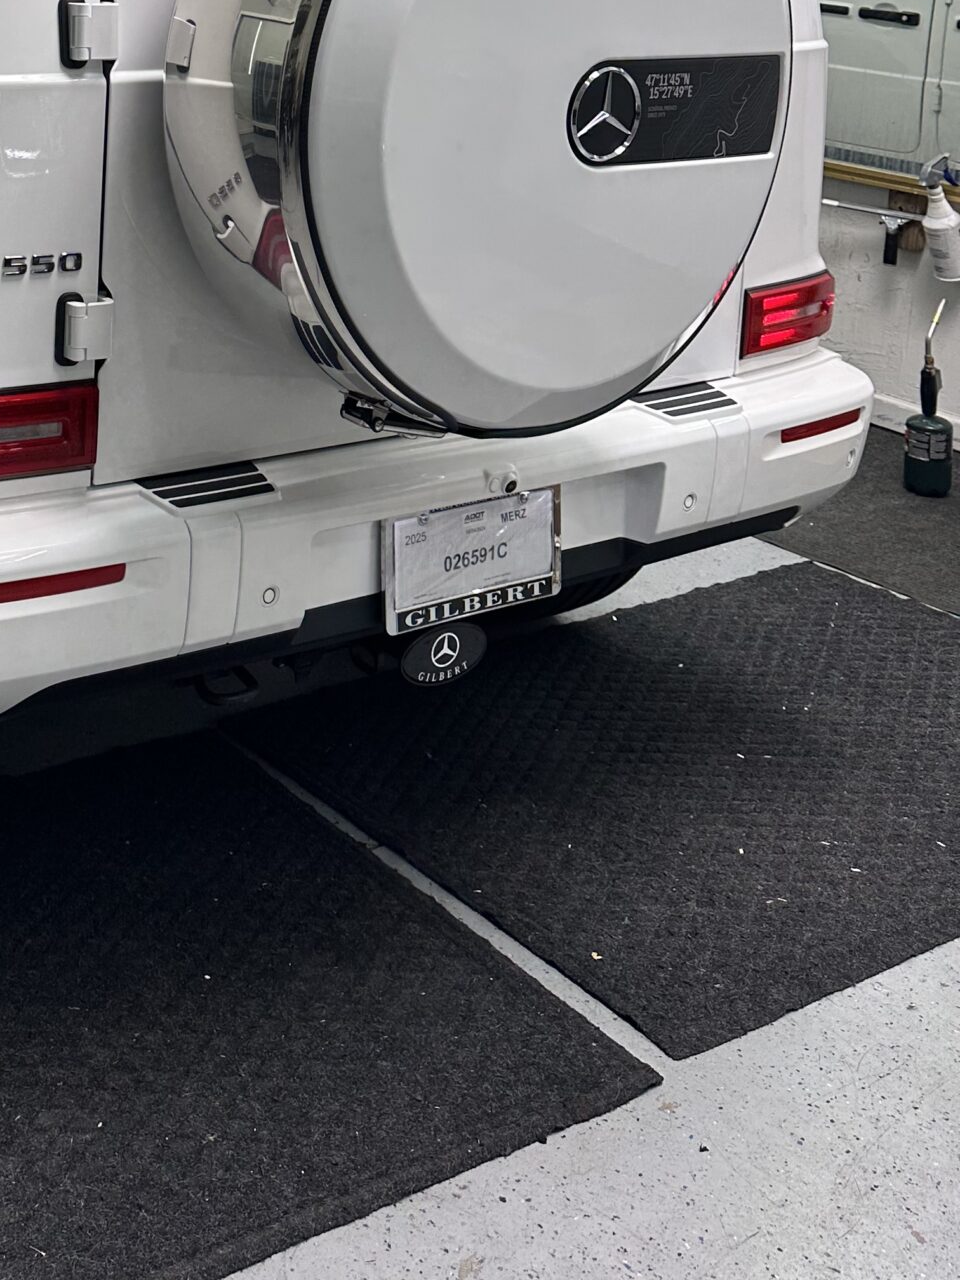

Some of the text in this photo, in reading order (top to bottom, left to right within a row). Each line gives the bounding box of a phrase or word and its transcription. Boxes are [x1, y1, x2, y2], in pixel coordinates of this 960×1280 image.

[2, 252, 83, 276] 550
[500, 508, 528, 524] MERZ
[405, 531, 427, 546] 2025
[444, 542, 508, 572] 026591C
[404, 580, 547, 627] GILBERT
[418, 660, 468, 682] GILBERT
